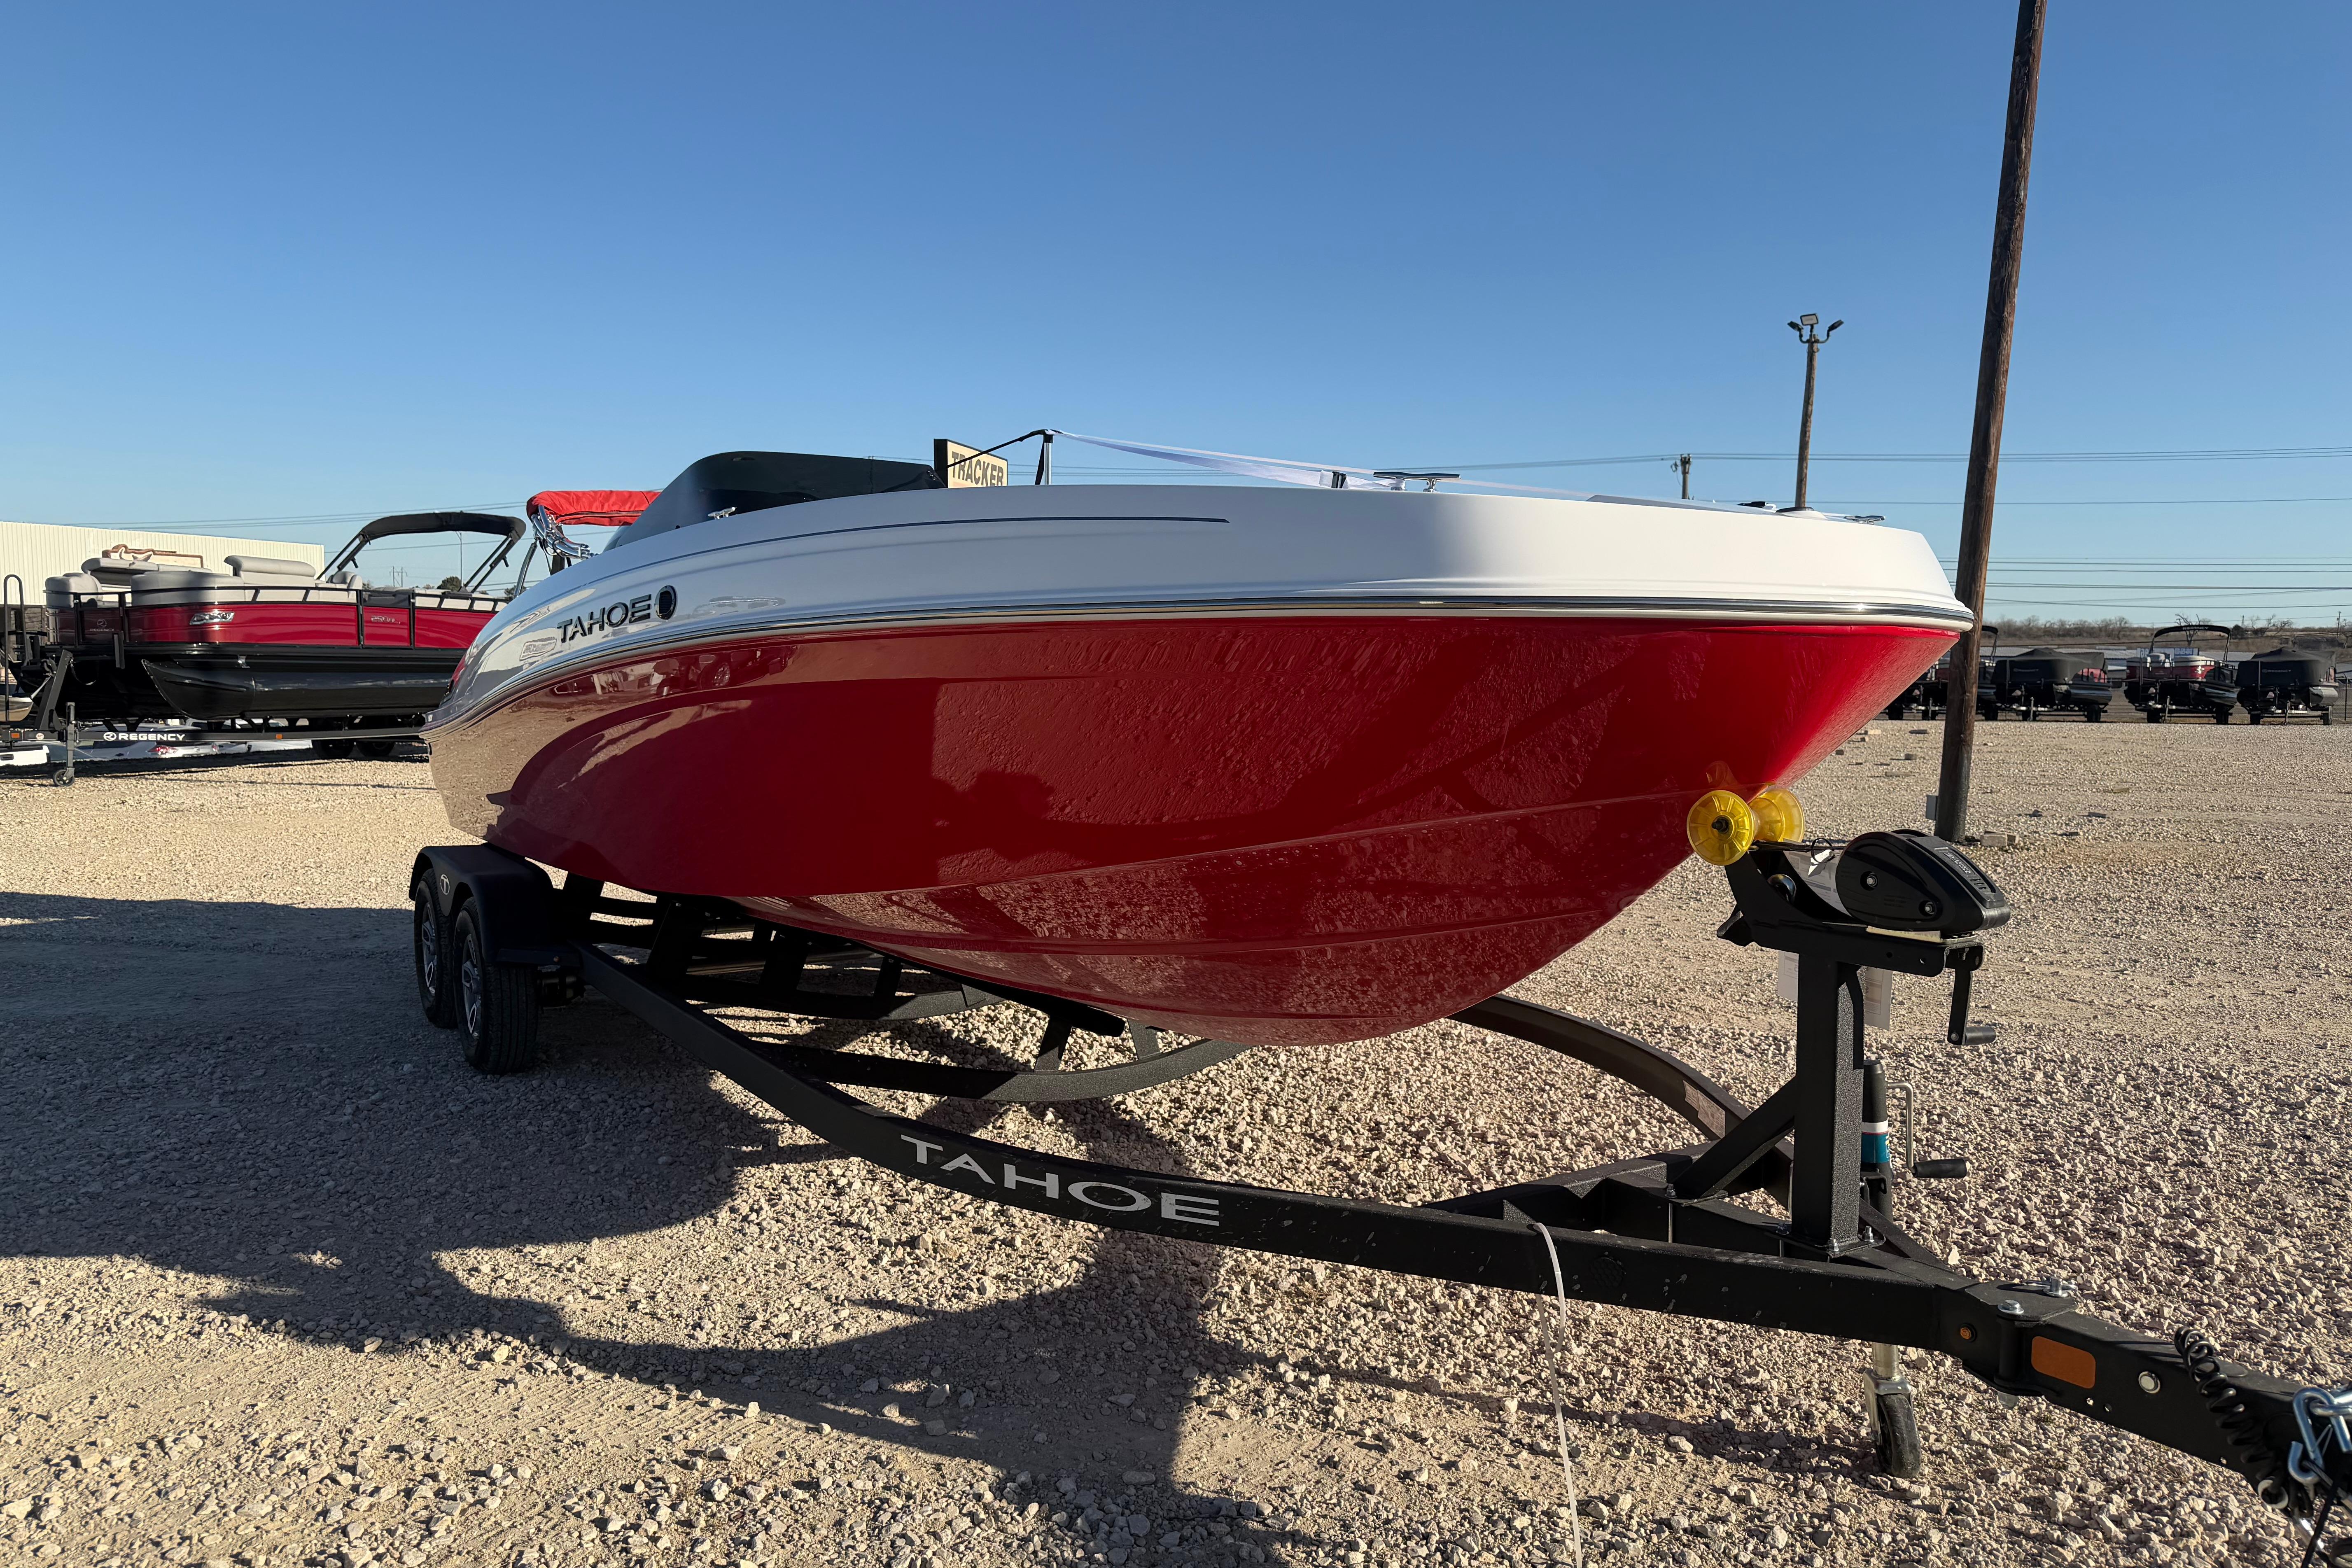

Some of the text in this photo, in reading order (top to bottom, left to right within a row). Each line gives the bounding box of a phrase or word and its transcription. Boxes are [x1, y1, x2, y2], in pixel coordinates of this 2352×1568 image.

[952, 451, 1004, 487] TRACKER
[557, 594, 651, 643] TAHOE
[900, 1134, 1220, 1226] TAHOE
